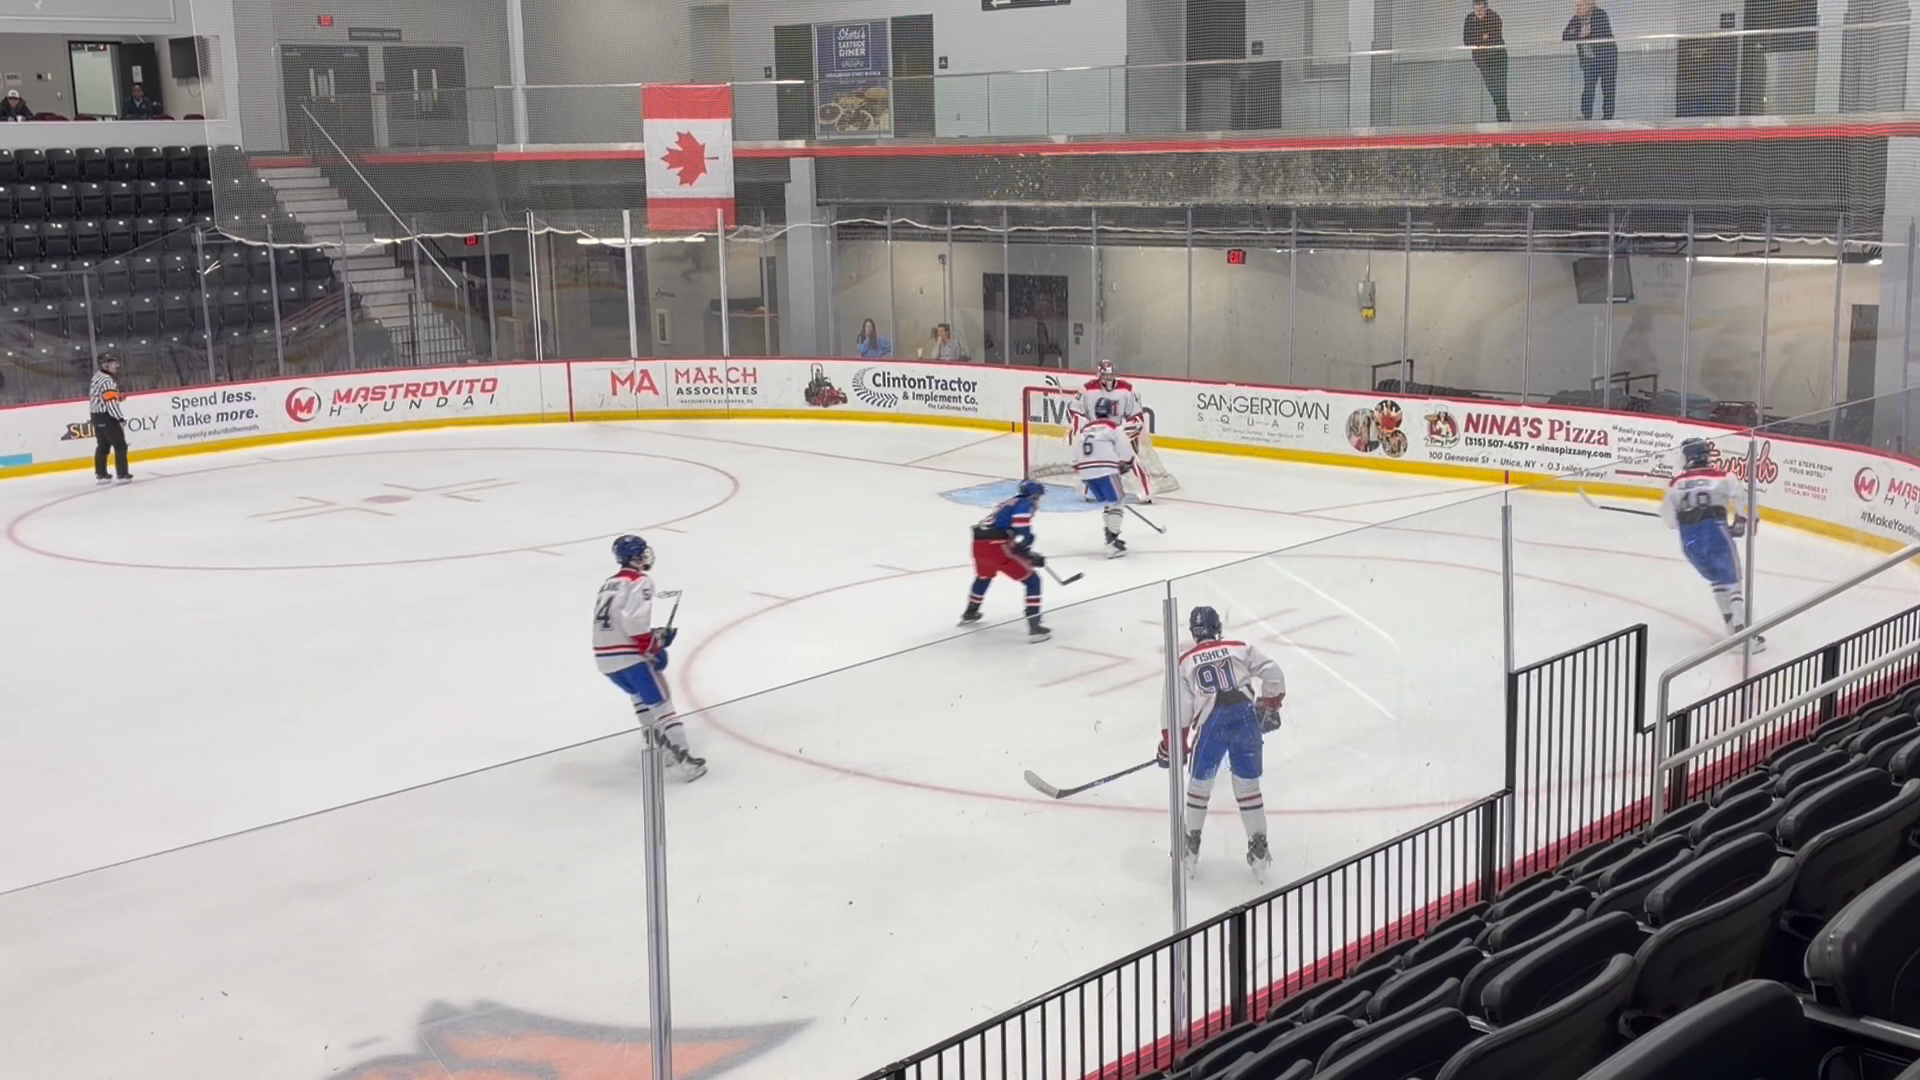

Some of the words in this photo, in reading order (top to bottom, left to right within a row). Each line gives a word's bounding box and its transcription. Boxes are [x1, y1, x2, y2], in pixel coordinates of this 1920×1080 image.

[838, 49, 866, 57] DINER
[610, 369, 660, 396] MA
[674, 367, 758, 384] MARCH
[872, 371, 978, 393] ClintonTractor
[171, 391, 217, 411] Spend
[221, 390, 256, 405] less.
[331, 377, 499, 405] MASTROVITO
[676, 386, 758, 396] ASSOCIATES
[902, 391, 910, 401] &
[912, 391, 962, 405] Implement
[964, 394, 979, 405] Co.
[329, 393, 495, 417] HYUNDAI
[1197, 393, 1330, 421] SANGERTOWN
[128, 415, 159, 432] OLY
[172, 411, 212, 428] Make
[215, 408, 259, 423] more.
[1197, 412, 1330, 434] SQUARE
[69, 422, 96, 439] SU
[1464, 413, 1543, 439] NINA'S
[1548, 419, 1609, 446] Pizza
[1464, 436, 1486, 447] (315)
[1487, 439, 1529, 451] 507-4577
[1536, 444, 1612, 460] ninaspizzany.com
[1428, 451, 1443, 461] 100
[1444, 452, 1480, 464] Genesee
[1481, 456, 1489, 464] St
[1524, 460, 1536, 469] NY
[1887, 477, 1920, 503] MAS
[1192, 647, 1230, 665] FISHER
[1196, 657, 1237, 694] 91
